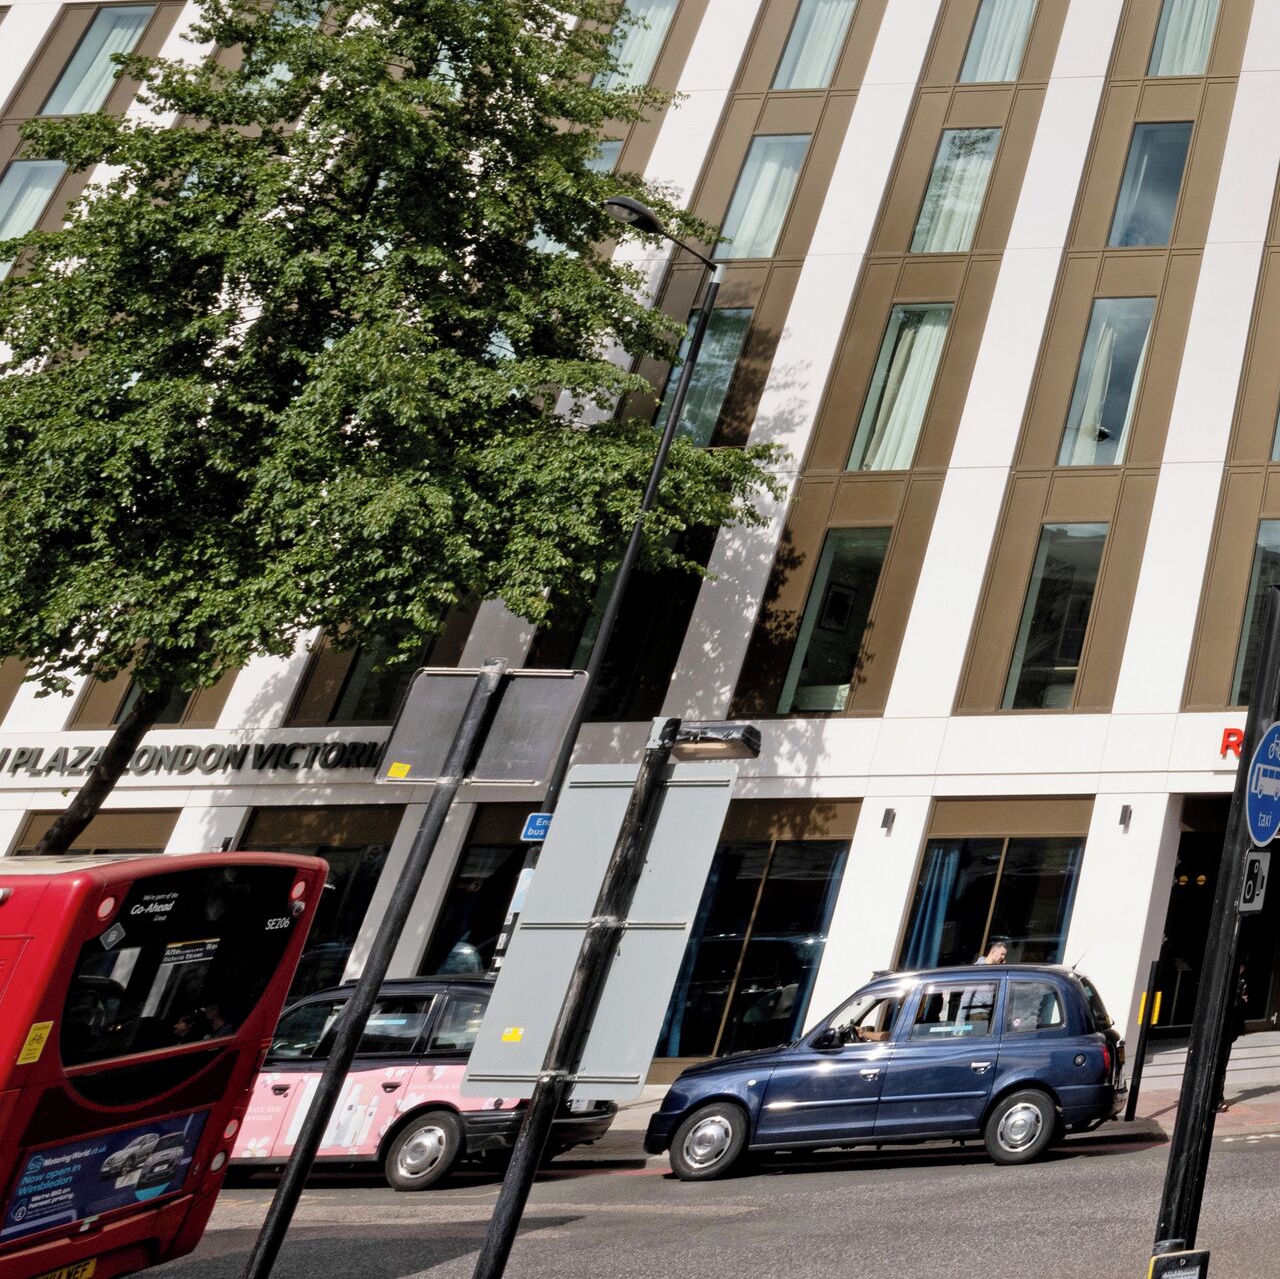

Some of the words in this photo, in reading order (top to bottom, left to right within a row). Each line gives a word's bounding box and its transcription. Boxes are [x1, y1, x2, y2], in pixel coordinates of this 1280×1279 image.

[121, 743, 250, 777] ONDON
[1257, 811, 1272, 828] taxi
[527, 827, 545, 836] bus
[130, 900, 175, 915] Go-Ahead
[265, 918, 290, 930] SE206
[21, 1174, 45, 1186] Now
[45, 1166, 72, 1180] open
[71, 1164, 82, 1173] in
[17, 1176, 73, 1196] Wimbledon
